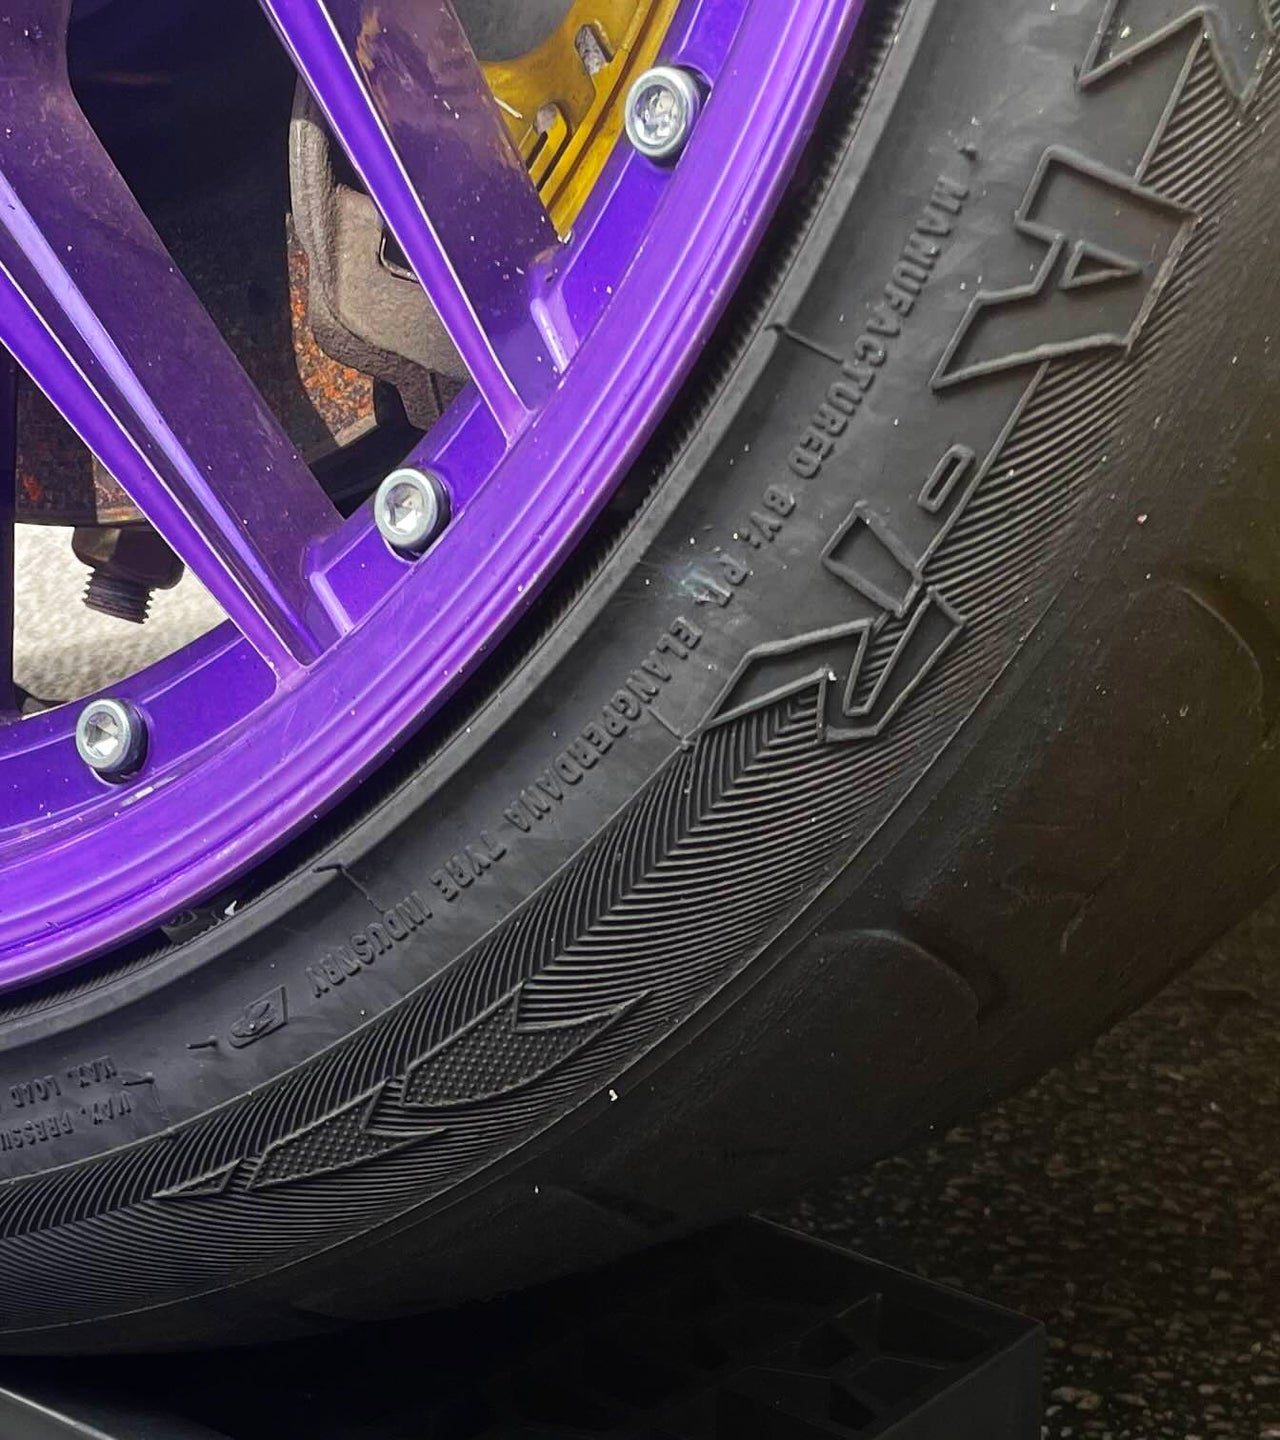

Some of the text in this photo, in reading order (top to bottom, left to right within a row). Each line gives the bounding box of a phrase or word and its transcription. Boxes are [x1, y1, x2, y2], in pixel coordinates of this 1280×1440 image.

[788, 174, 969, 480] MANUFACTURED
[738, 484, 796, 549] BY:
[504, 615, 703, 833] ELANGPERDANA
[429, 830, 507, 902] TYRE
[303, 890, 434, 998] INDUSTRY
[10, 1075, 62, 1108] LOAD
